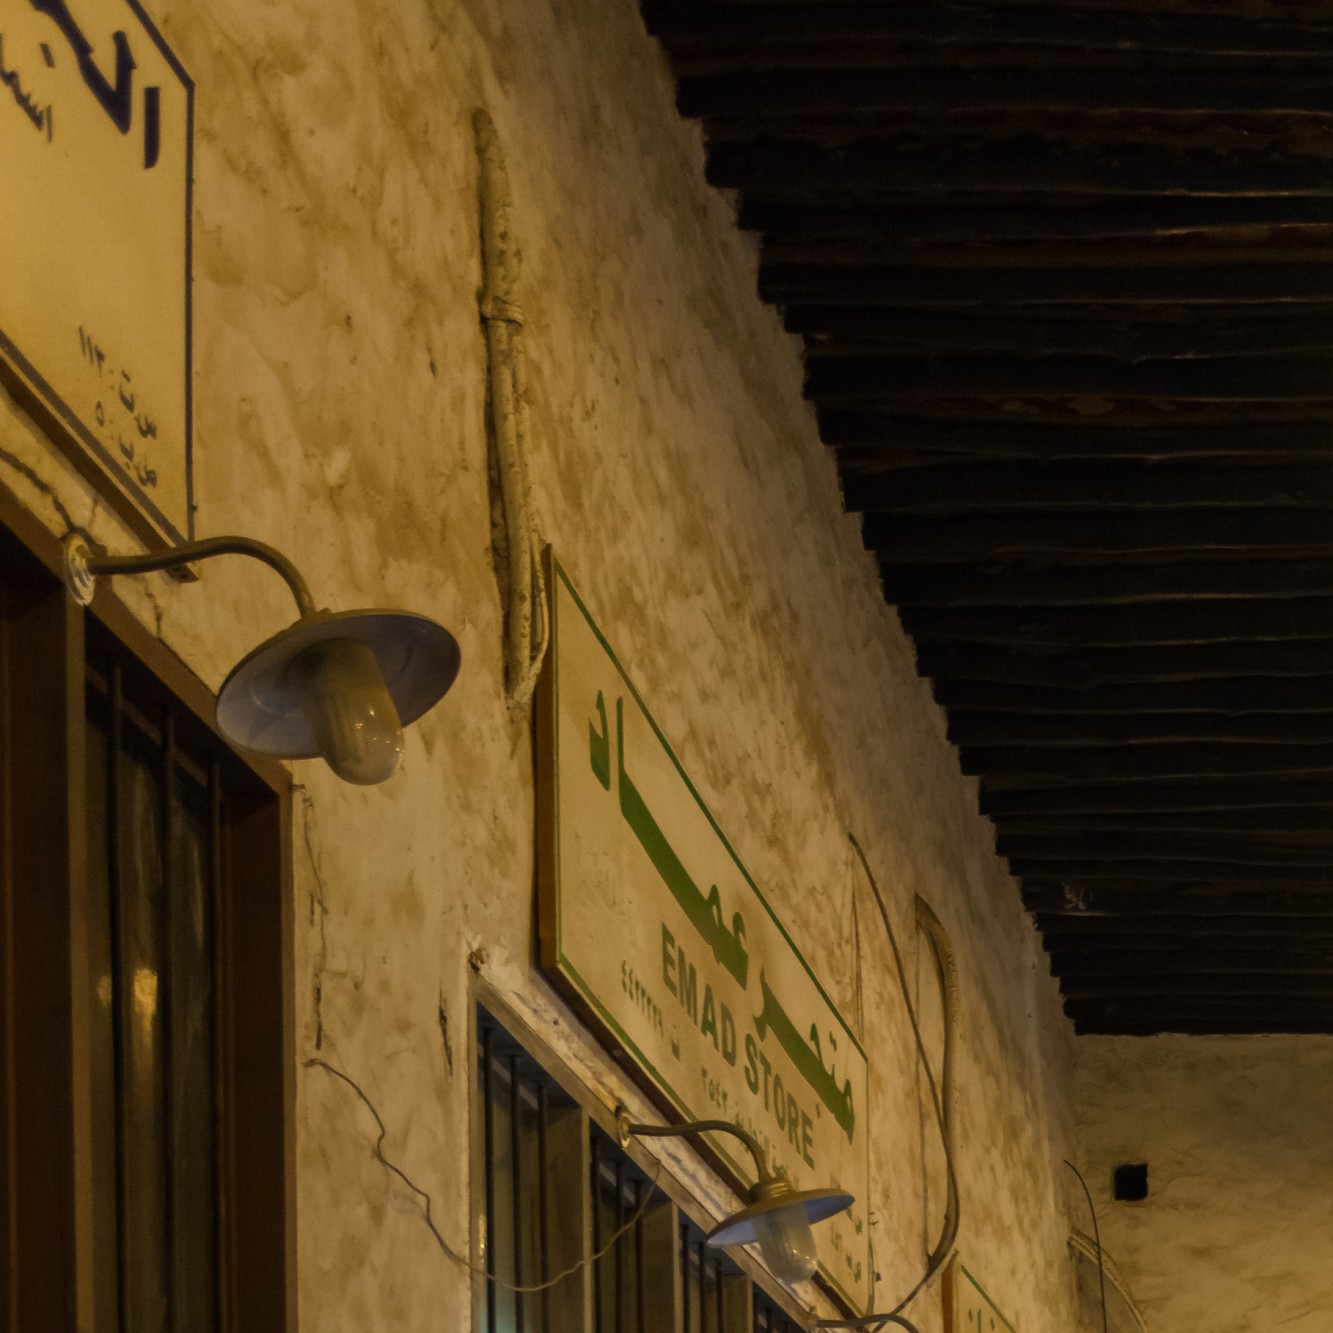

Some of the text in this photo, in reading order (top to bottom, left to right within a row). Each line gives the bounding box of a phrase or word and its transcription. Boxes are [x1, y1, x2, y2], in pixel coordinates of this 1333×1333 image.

[588, 689, 750, 991] عماد
[661, 920, 738, 1069] EMAD
[743, 1040, 817, 1171] STORE
[754, 966, 856, 1144] متجر
